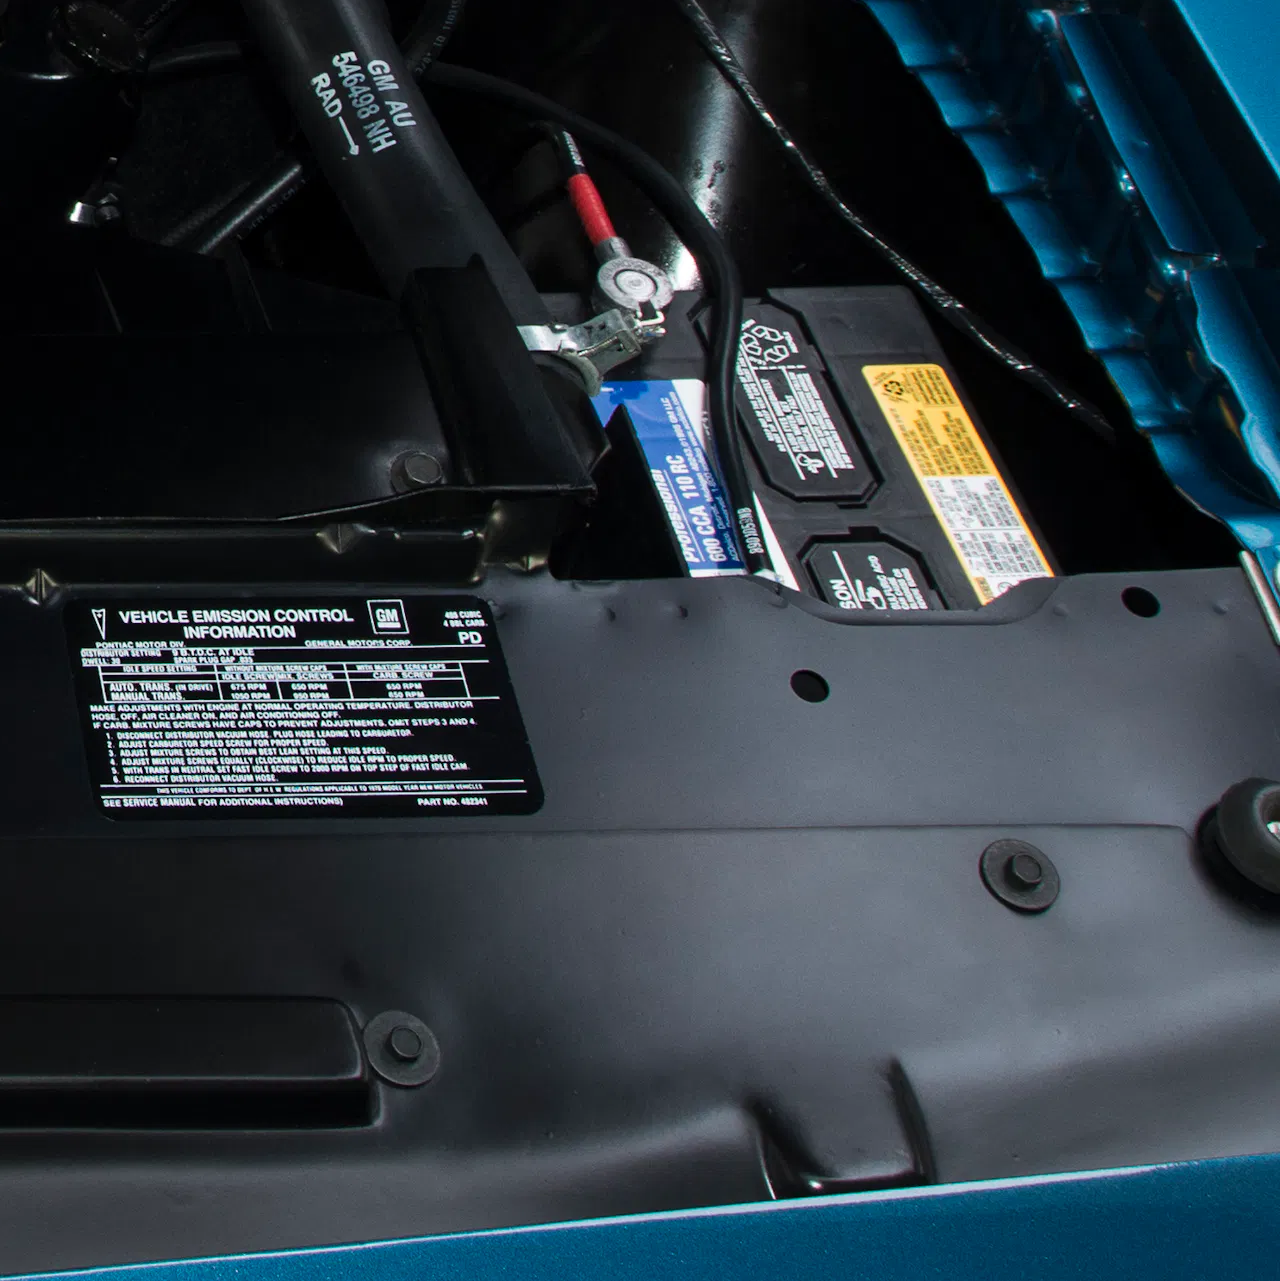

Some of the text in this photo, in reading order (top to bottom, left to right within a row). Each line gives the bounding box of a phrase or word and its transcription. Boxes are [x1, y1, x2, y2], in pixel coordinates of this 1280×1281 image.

[311, 72, 342, 118] RAD
[368, 59, 416, 127] GM AU
[332, 51, 396, 153] 546498 NH
[660, 397, 672, 410] LLC
[666, 455, 690, 473] RC
[675, 476, 701, 499] 110
[688, 505, 715, 535] CCA
[703, 538, 726, 562] 600
[829, 579, 857, 609] SON
[118, 608, 354, 624] VEHICLE EMISSION CONTROL
[373, 608, 400, 623] GM
[441, 619, 449, 627] 4
[182, 624, 297, 639] INFORMATION
[456, 630, 484, 644] PD
[134, 640, 167, 648] MOTOR
[231, 648, 255, 656] IDLE
[108, 682, 137, 693] AUTO.
[138, 682, 173, 692] TRANS.
[109, 691, 186, 701] MANUAL TRANS.
[249, 691, 271, 699] RPM
[308, 691, 330, 699] RPM
[89, 704, 116, 712] MAKE
[116, 703, 182, 712] ADJUSTMENTS
[181, 703, 206, 711] WITH
[205, 703, 240, 711] ENGINE
[253, 702, 293, 710] NORMAL
[292, 702, 345, 710] OPERATING
[140, 712, 157, 720] AIR
[157, 712, 200, 720] CLEANER
[218, 711, 239, 719] AND
[238, 711, 256, 719] AIR
[255, 710, 321, 719] CONDITIONING
[92, 721, 101, 729] IF
[131, 721, 172, 729] MIXTURE
[171, 720, 211, 728] SCREWS
[211, 720, 237, 728] HAVE
[236, 719, 263, 728] CAPS
[262, 719, 277, 728] TO
[276, 719, 319, 728] PREVENT
[410, 718, 441, 726] STEPS
[440, 718, 448, 726] 3
[447, 717, 469, 725] AND
[102, 798, 122, 807] SEE
[122, 797, 158, 807] SERVICE
[159, 797, 196, 806] MANUAL
[197, 798, 218, 806] FOR
[217, 797, 273, 806] ADDITIONAL
[416, 797, 442, 806] PART
[441, 797, 460, 806] NO.
